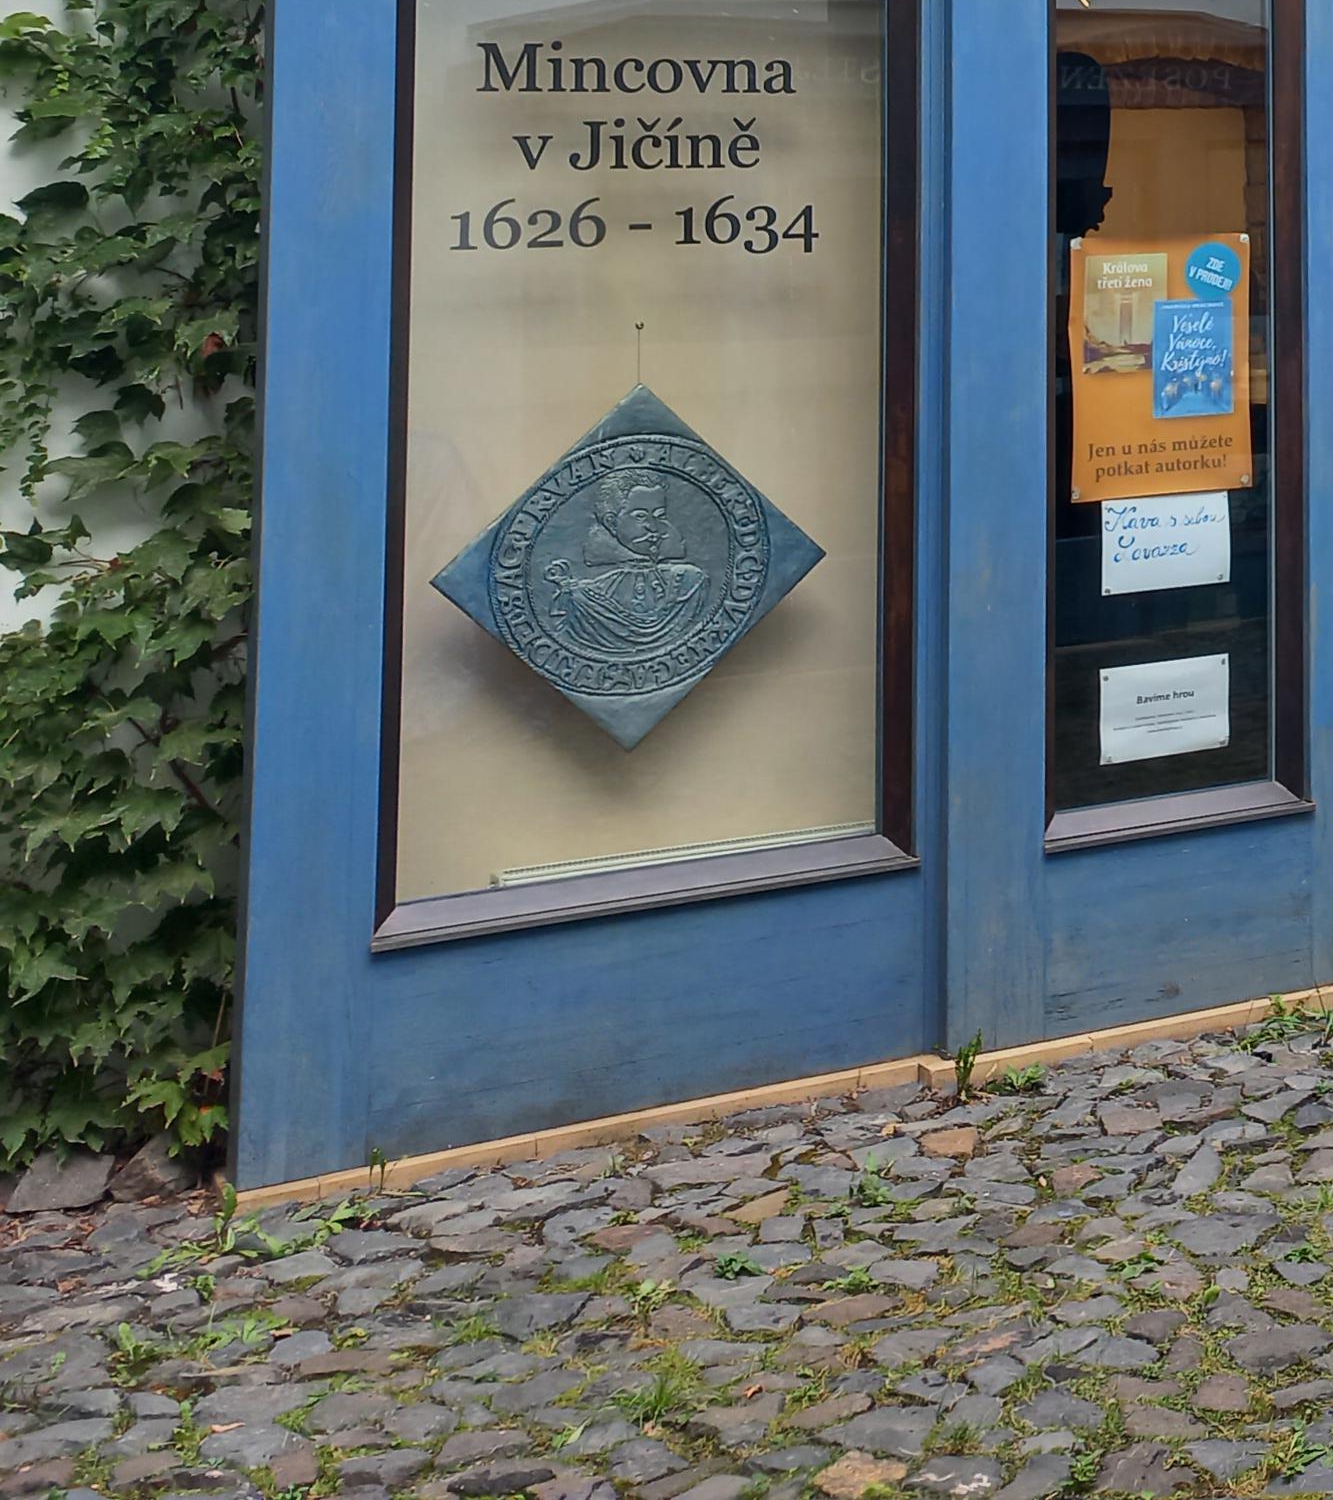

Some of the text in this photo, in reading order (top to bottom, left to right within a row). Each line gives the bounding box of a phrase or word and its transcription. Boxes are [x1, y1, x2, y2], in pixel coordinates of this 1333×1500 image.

[476, 40, 796, 94] Mincovna
[513, 117, 761, 171] v Jičíně
[450, 197, 607, 251] 1626
[674, 195, 820, 254] 1634
[1087, 443, 1116, 461] Jen
[1122, 443, 1132, 455] u
[1137, 439, 1166, 454] nás
[1095, 454, 1227, 483] potkat autorku!
